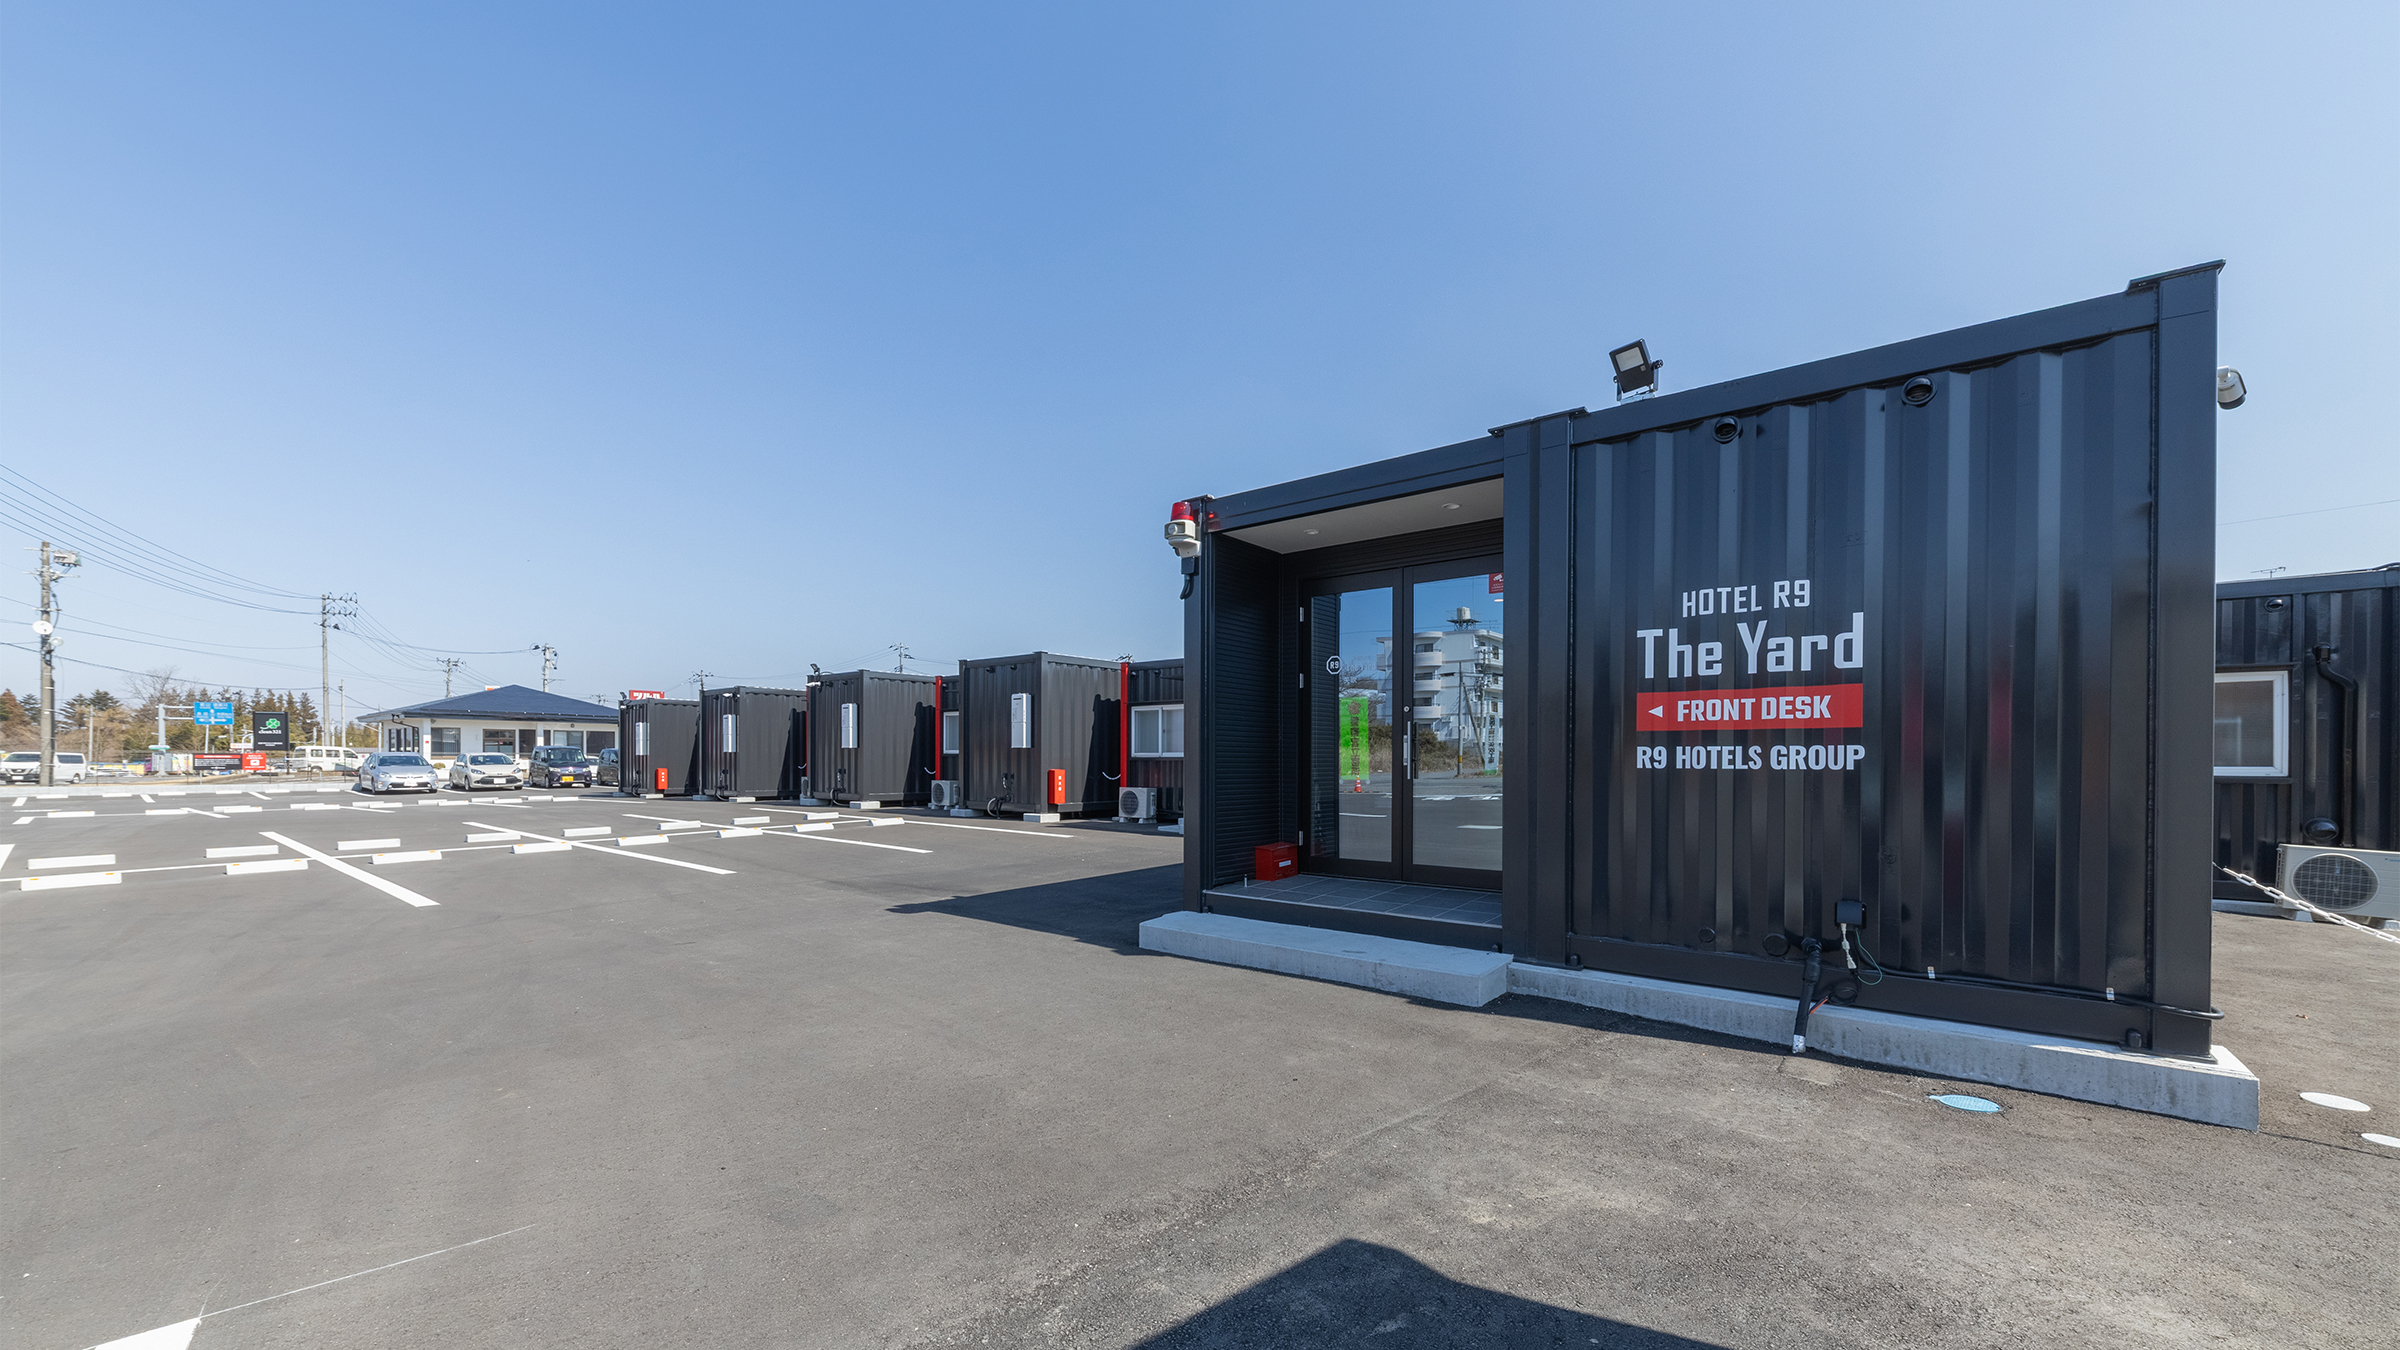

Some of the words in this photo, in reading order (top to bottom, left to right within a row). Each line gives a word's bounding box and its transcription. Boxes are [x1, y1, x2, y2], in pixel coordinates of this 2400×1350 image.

[1682, 585, 1762, 618] HOTEL
[1773, 579, 1810, 608] R9
[1636, 628, 1723, 679] The
[1736, 612, 1864, 675] Yard
[1329, 661, 1339, 669] R9
[1677, 697, 1756, 722] FRONT
[1761, 695, 1832, 720] DESK
[1636, 746, 1667, 770] R9
[1676, 745, 1762, 771] HOTELS
[1769, 744, 1866, 771] GROUP
